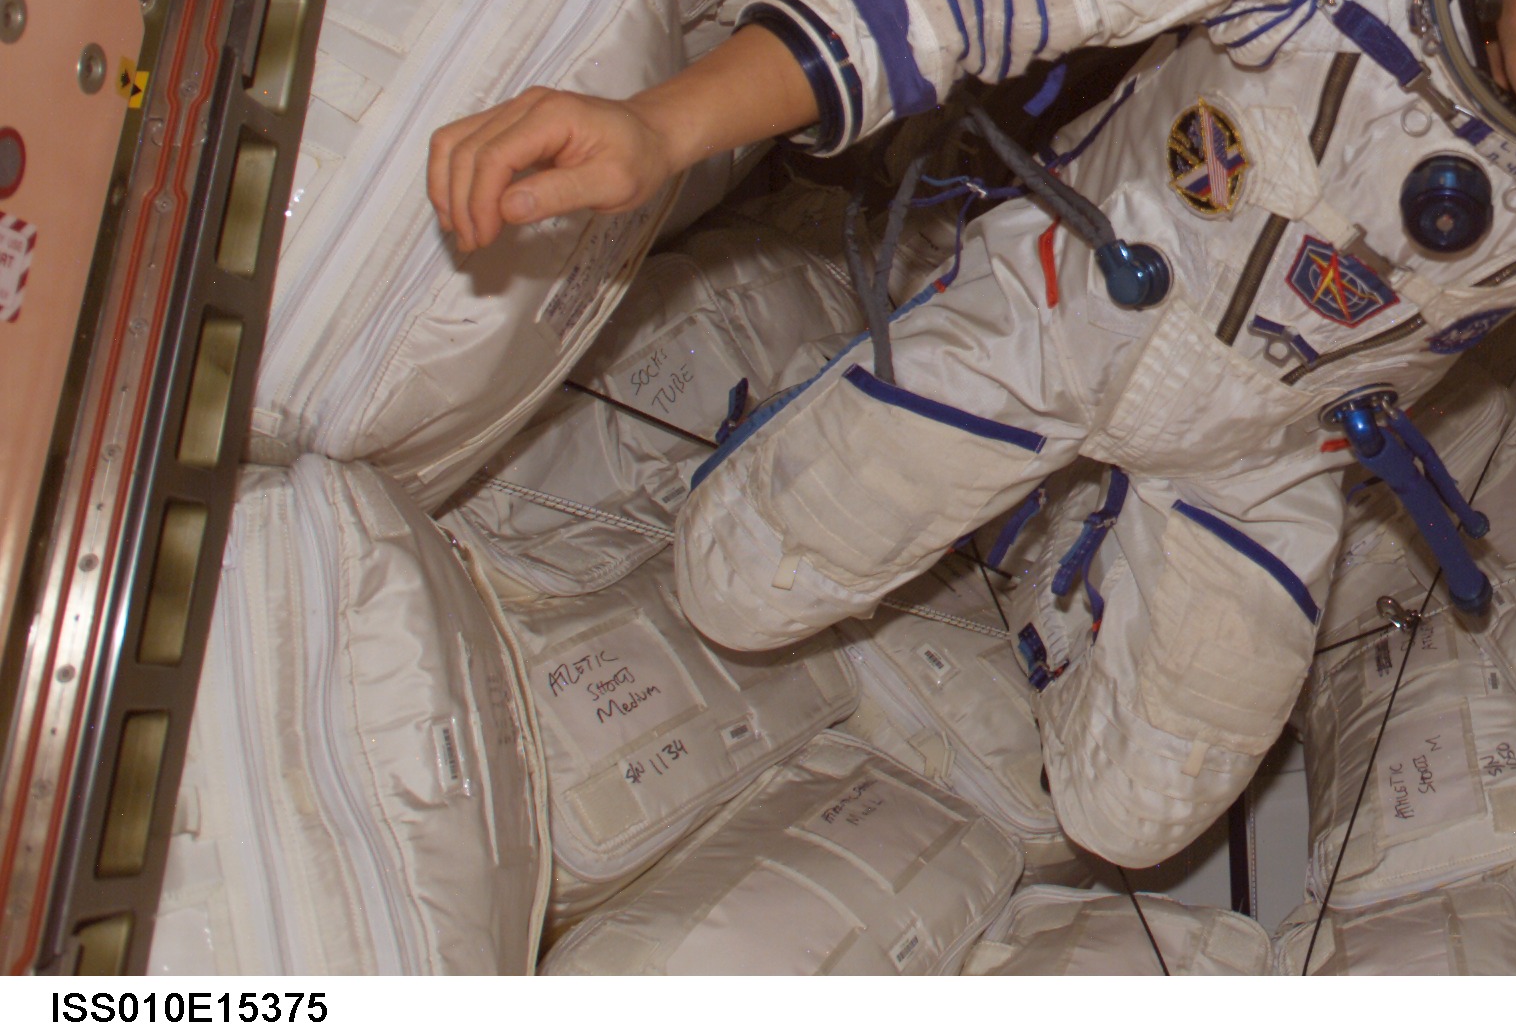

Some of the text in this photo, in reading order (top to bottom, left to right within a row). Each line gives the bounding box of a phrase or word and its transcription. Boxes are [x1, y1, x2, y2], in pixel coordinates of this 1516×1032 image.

[631, 349, 668, 396] SOCKS
[652, 364, 693, 414] TUBE
[597, 686, 661, 723] Medium
[650, 739, 688, 775] 1134
[1480, 755, 1506, 777] S/N
[1390, 763, 1415, 819] ATHLETIC
